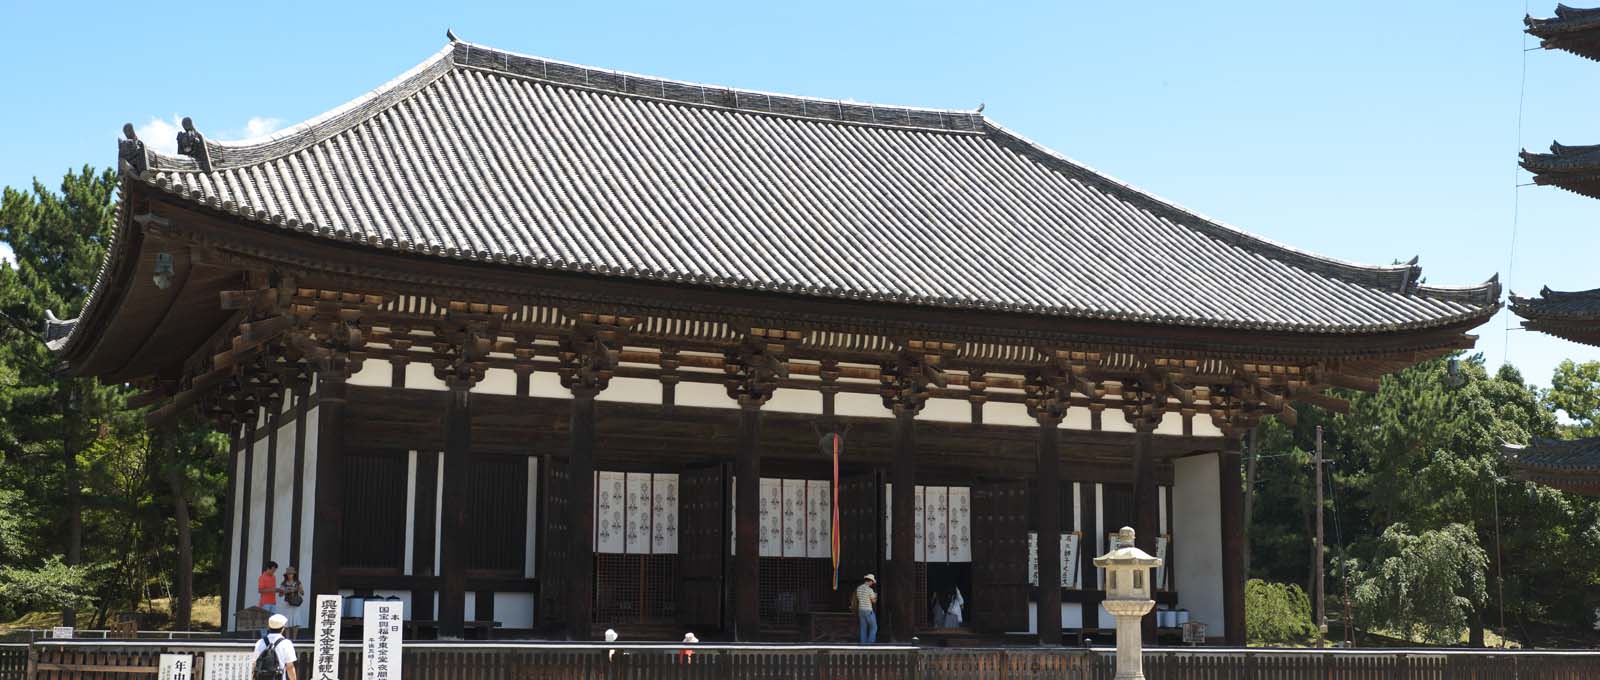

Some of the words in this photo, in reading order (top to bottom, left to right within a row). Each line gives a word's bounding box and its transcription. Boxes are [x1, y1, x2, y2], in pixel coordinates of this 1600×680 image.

[376, 606, 390, 680] 国宝興福寺東金堂夜間
[390, 614, 400, 632] 本日
